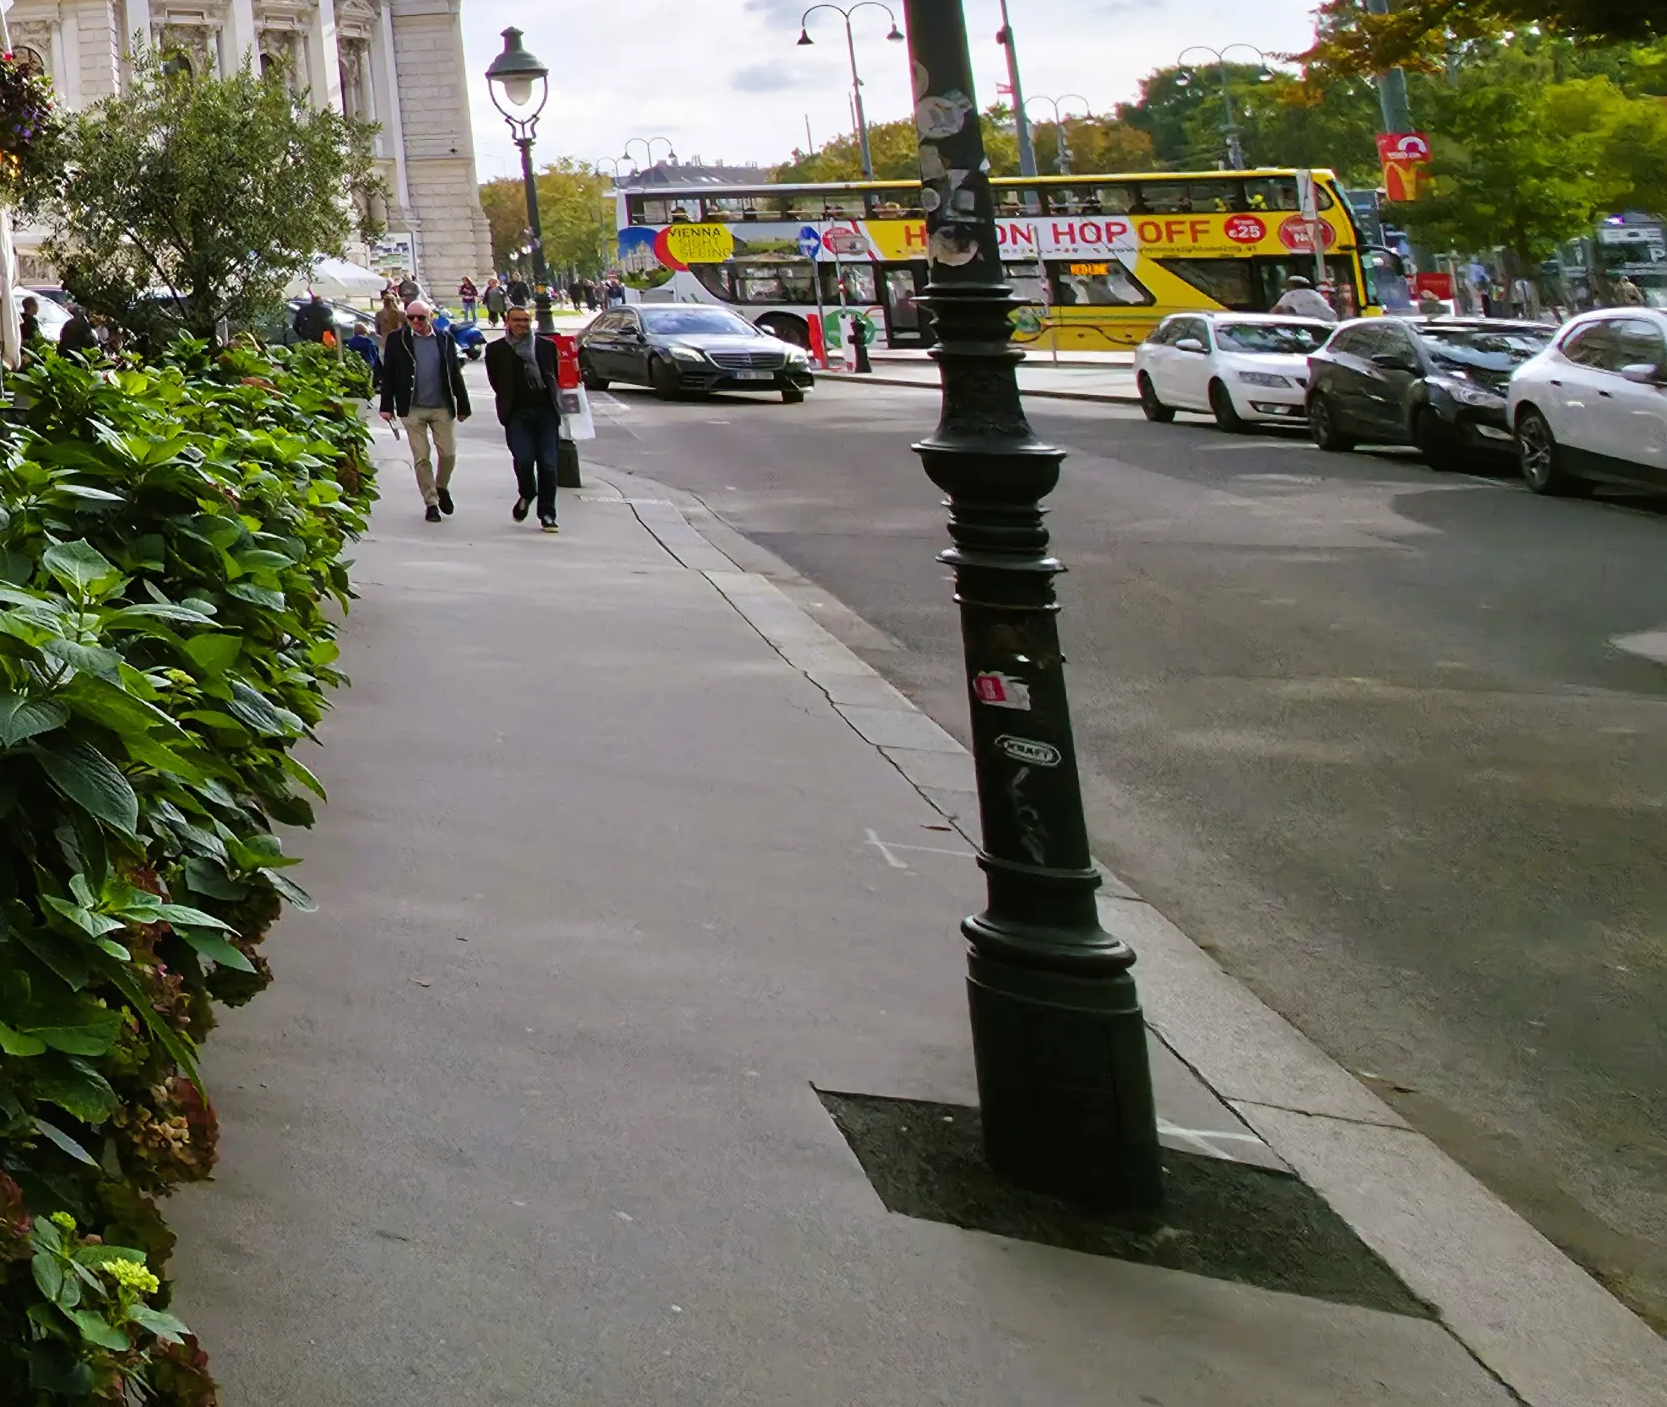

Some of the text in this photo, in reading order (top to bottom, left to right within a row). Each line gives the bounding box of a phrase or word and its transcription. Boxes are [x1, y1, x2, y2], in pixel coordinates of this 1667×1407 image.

[669, 227, 721, 237] VIENNA
[1052, 221, 1128, 245] HOP
[1137, 220, 1211, 244] OFF
